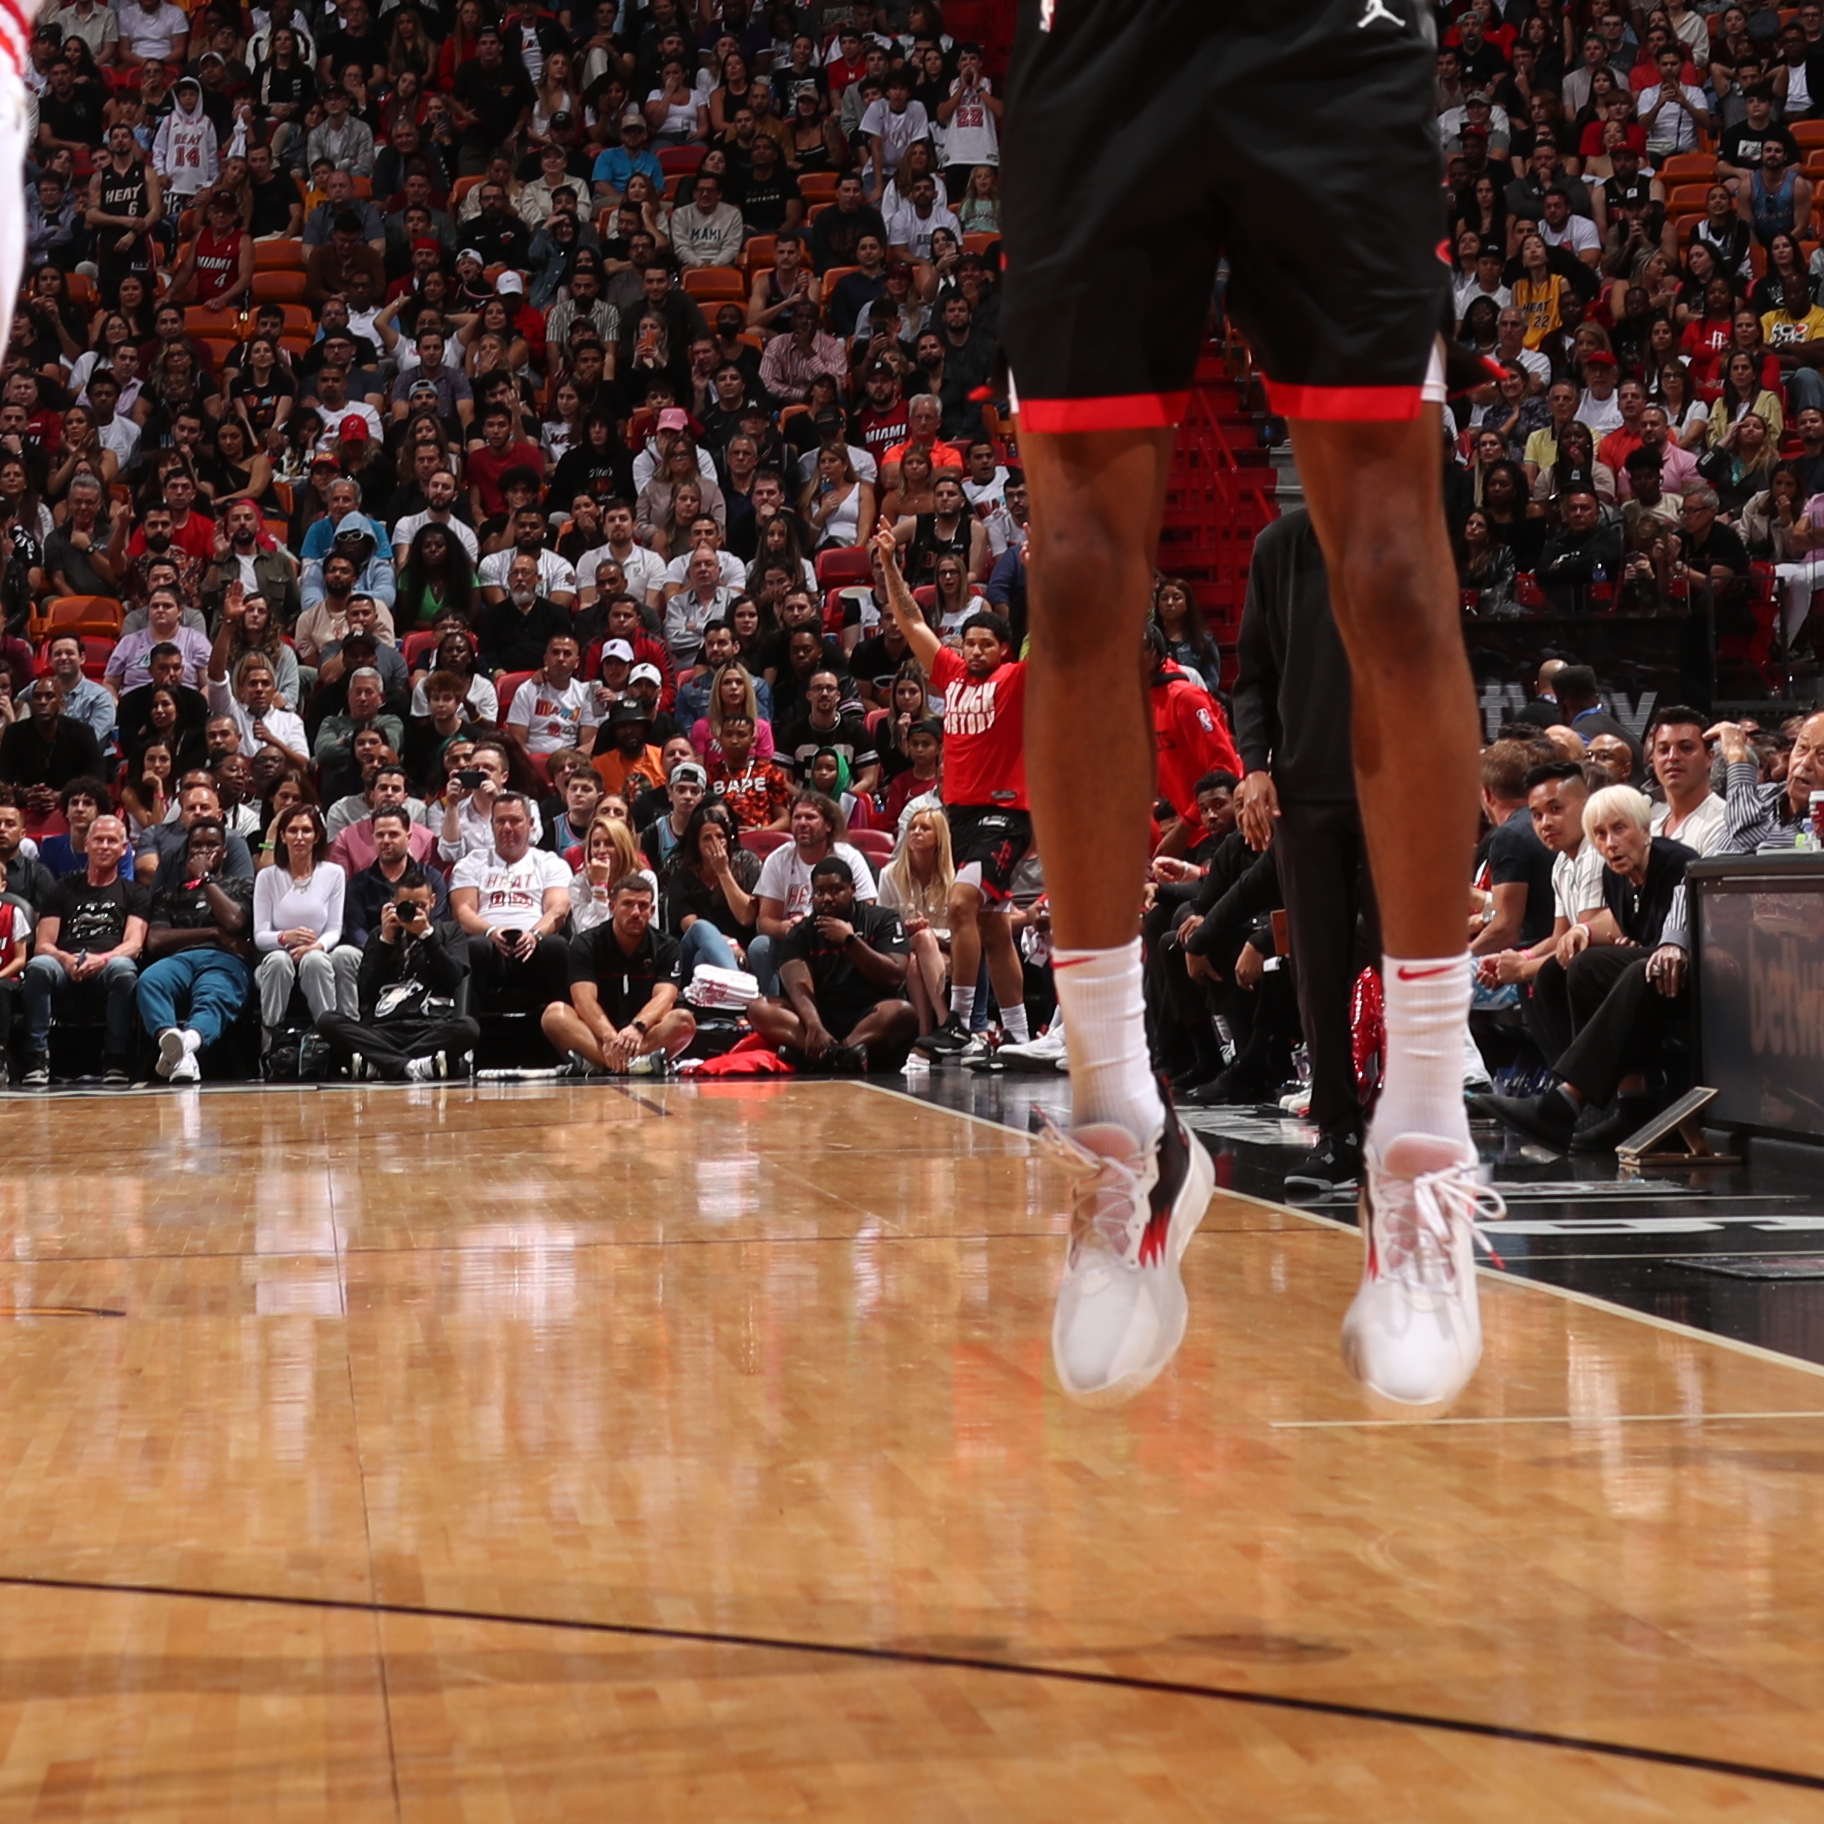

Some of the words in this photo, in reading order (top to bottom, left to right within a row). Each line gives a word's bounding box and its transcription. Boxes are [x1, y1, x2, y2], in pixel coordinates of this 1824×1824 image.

[957, 108, 984, 127] 22
[175, 146, 200, 168] 14
[105, 181, 144, 205] HEAT
[127, 201, 138, 217] 6
[196, 255, 233, 271] MIAMI
[214, 272, 227, 288] 4
[1522, 298, 1550, 314] HEAT
[1533, 315, 1549, 329] 22
[862, 422, 908, 445] MIAMI
[713, 776, 767, 795] BAPE
